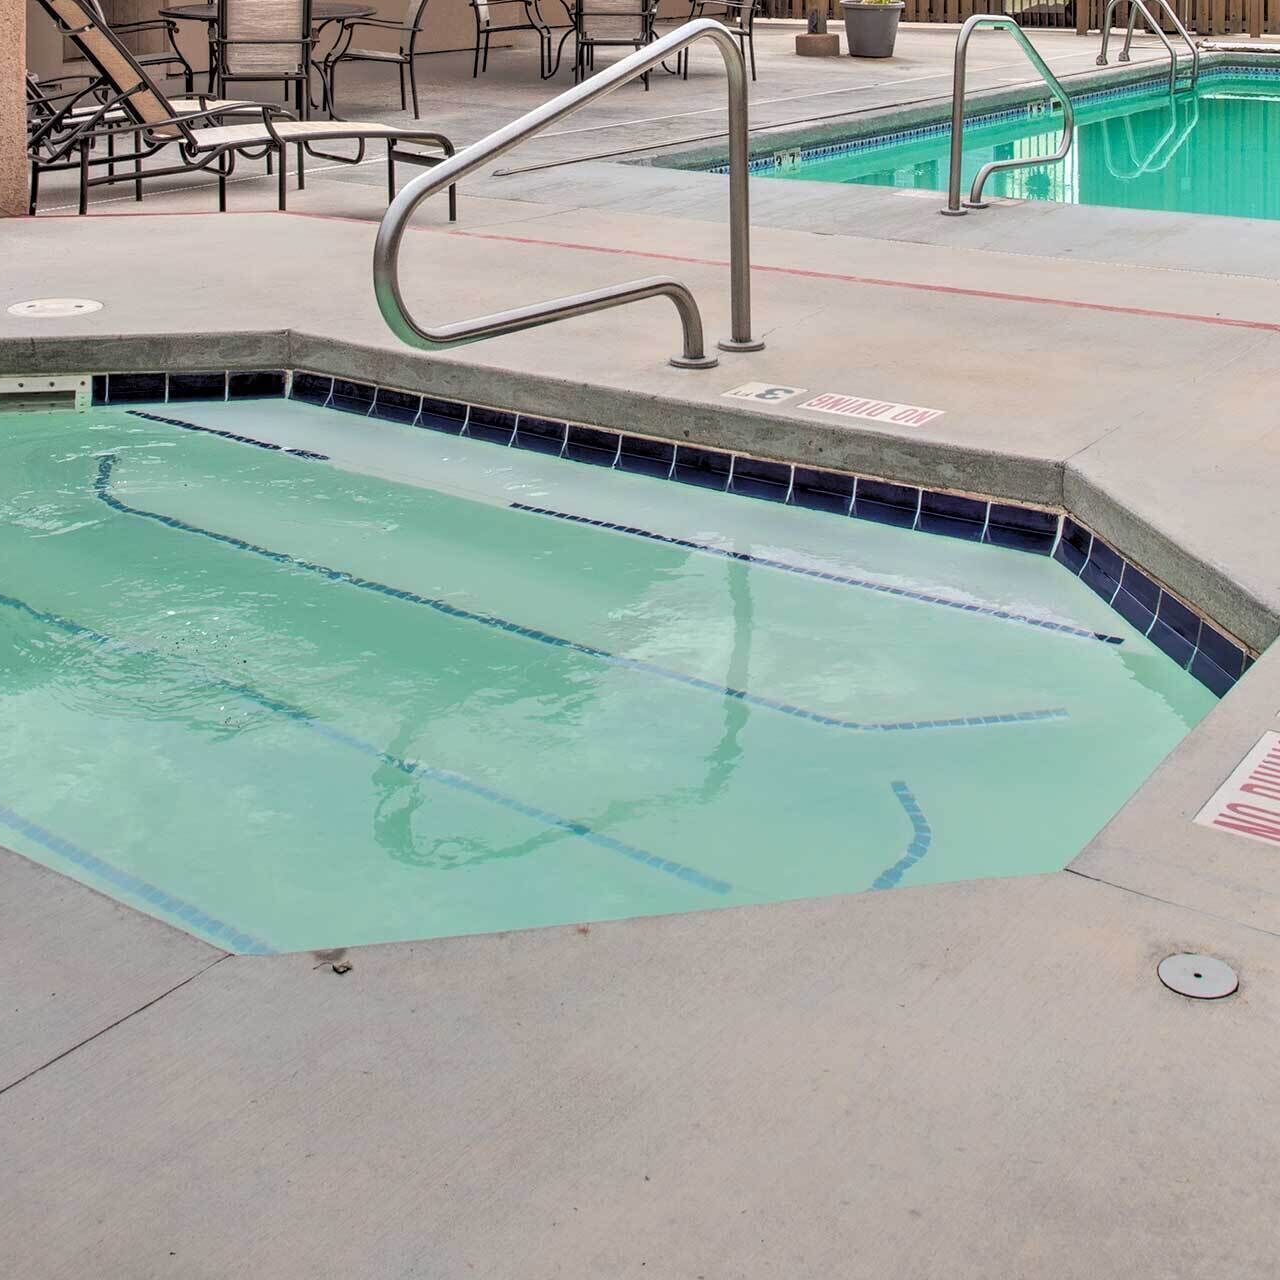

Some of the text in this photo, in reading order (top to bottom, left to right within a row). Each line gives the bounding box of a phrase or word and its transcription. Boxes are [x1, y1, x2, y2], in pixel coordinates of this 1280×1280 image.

[755, 387, 795, 400] 3
[806, 394, 939, 424] NO DIVING
